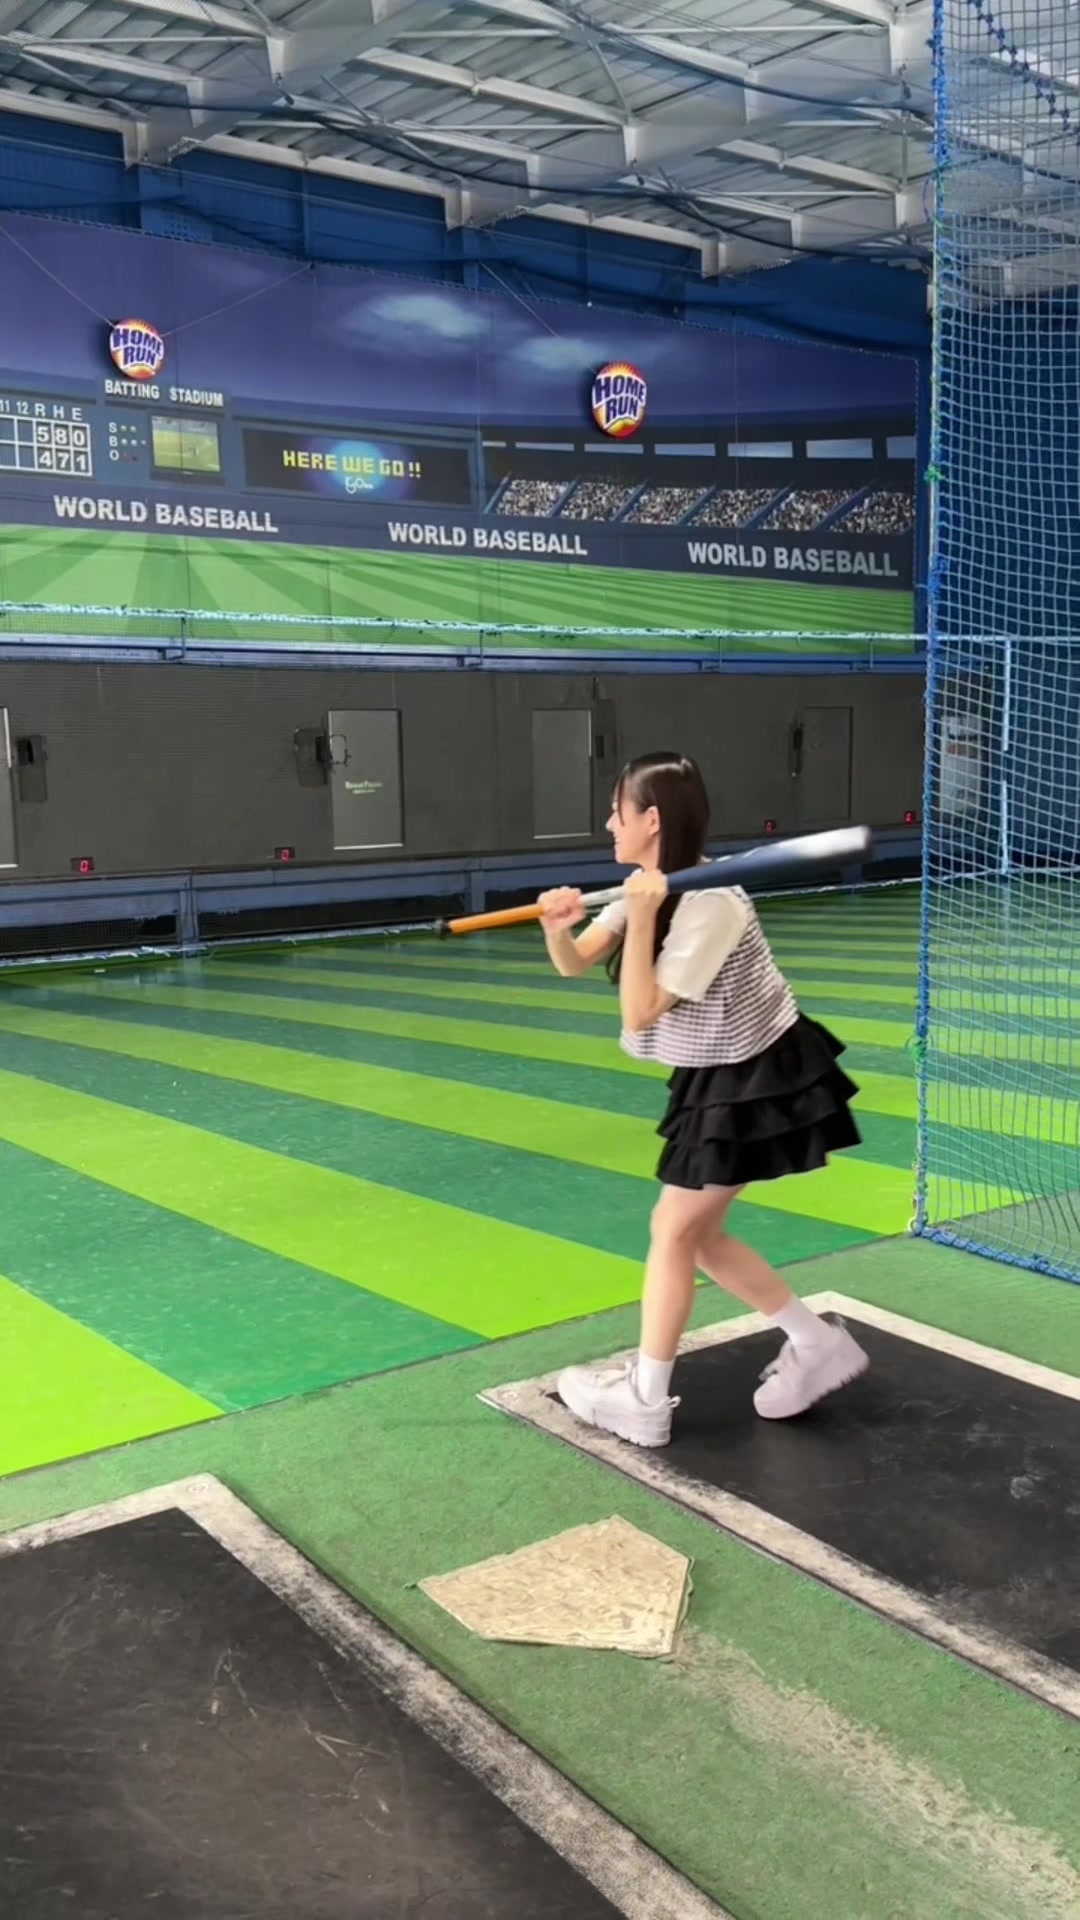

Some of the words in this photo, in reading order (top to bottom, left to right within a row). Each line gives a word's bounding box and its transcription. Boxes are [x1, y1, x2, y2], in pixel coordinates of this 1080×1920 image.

[113, 328, 163, 356] HOME
[123, 346, 156, 366] RUN
[104, 379, 160, 399] BATTING
[169, 387, 223, 407] STADIUM
[595, 375, 645, 405] HOME
[16, 401, 29, 415] 12
[35, 403, 46, 417] R
[53, 405, 65, 419] H
[72, 407, 83, 421] E
[605, 396, 639, 424] RUN
[108, 422, 118, 433] S
[109, 435, 118, 447] B
[109, 449, 119, 461] O
[283, 449, 337, 471] HERE
[342, 456, 375, 475] WE
[54, 494, 148, 522] WORLD
[155, 503, 279, 533] BASEBALL
[387, 521, 467, 547] WORLD
[473, 528, 588, 555] BASEBALL
[687, 541, 767, 568] WORLD
[774, 547, 899, 577] BASEBALL
[80, 860, 88, 872] 0
[281, 849, 290, 861] 0
